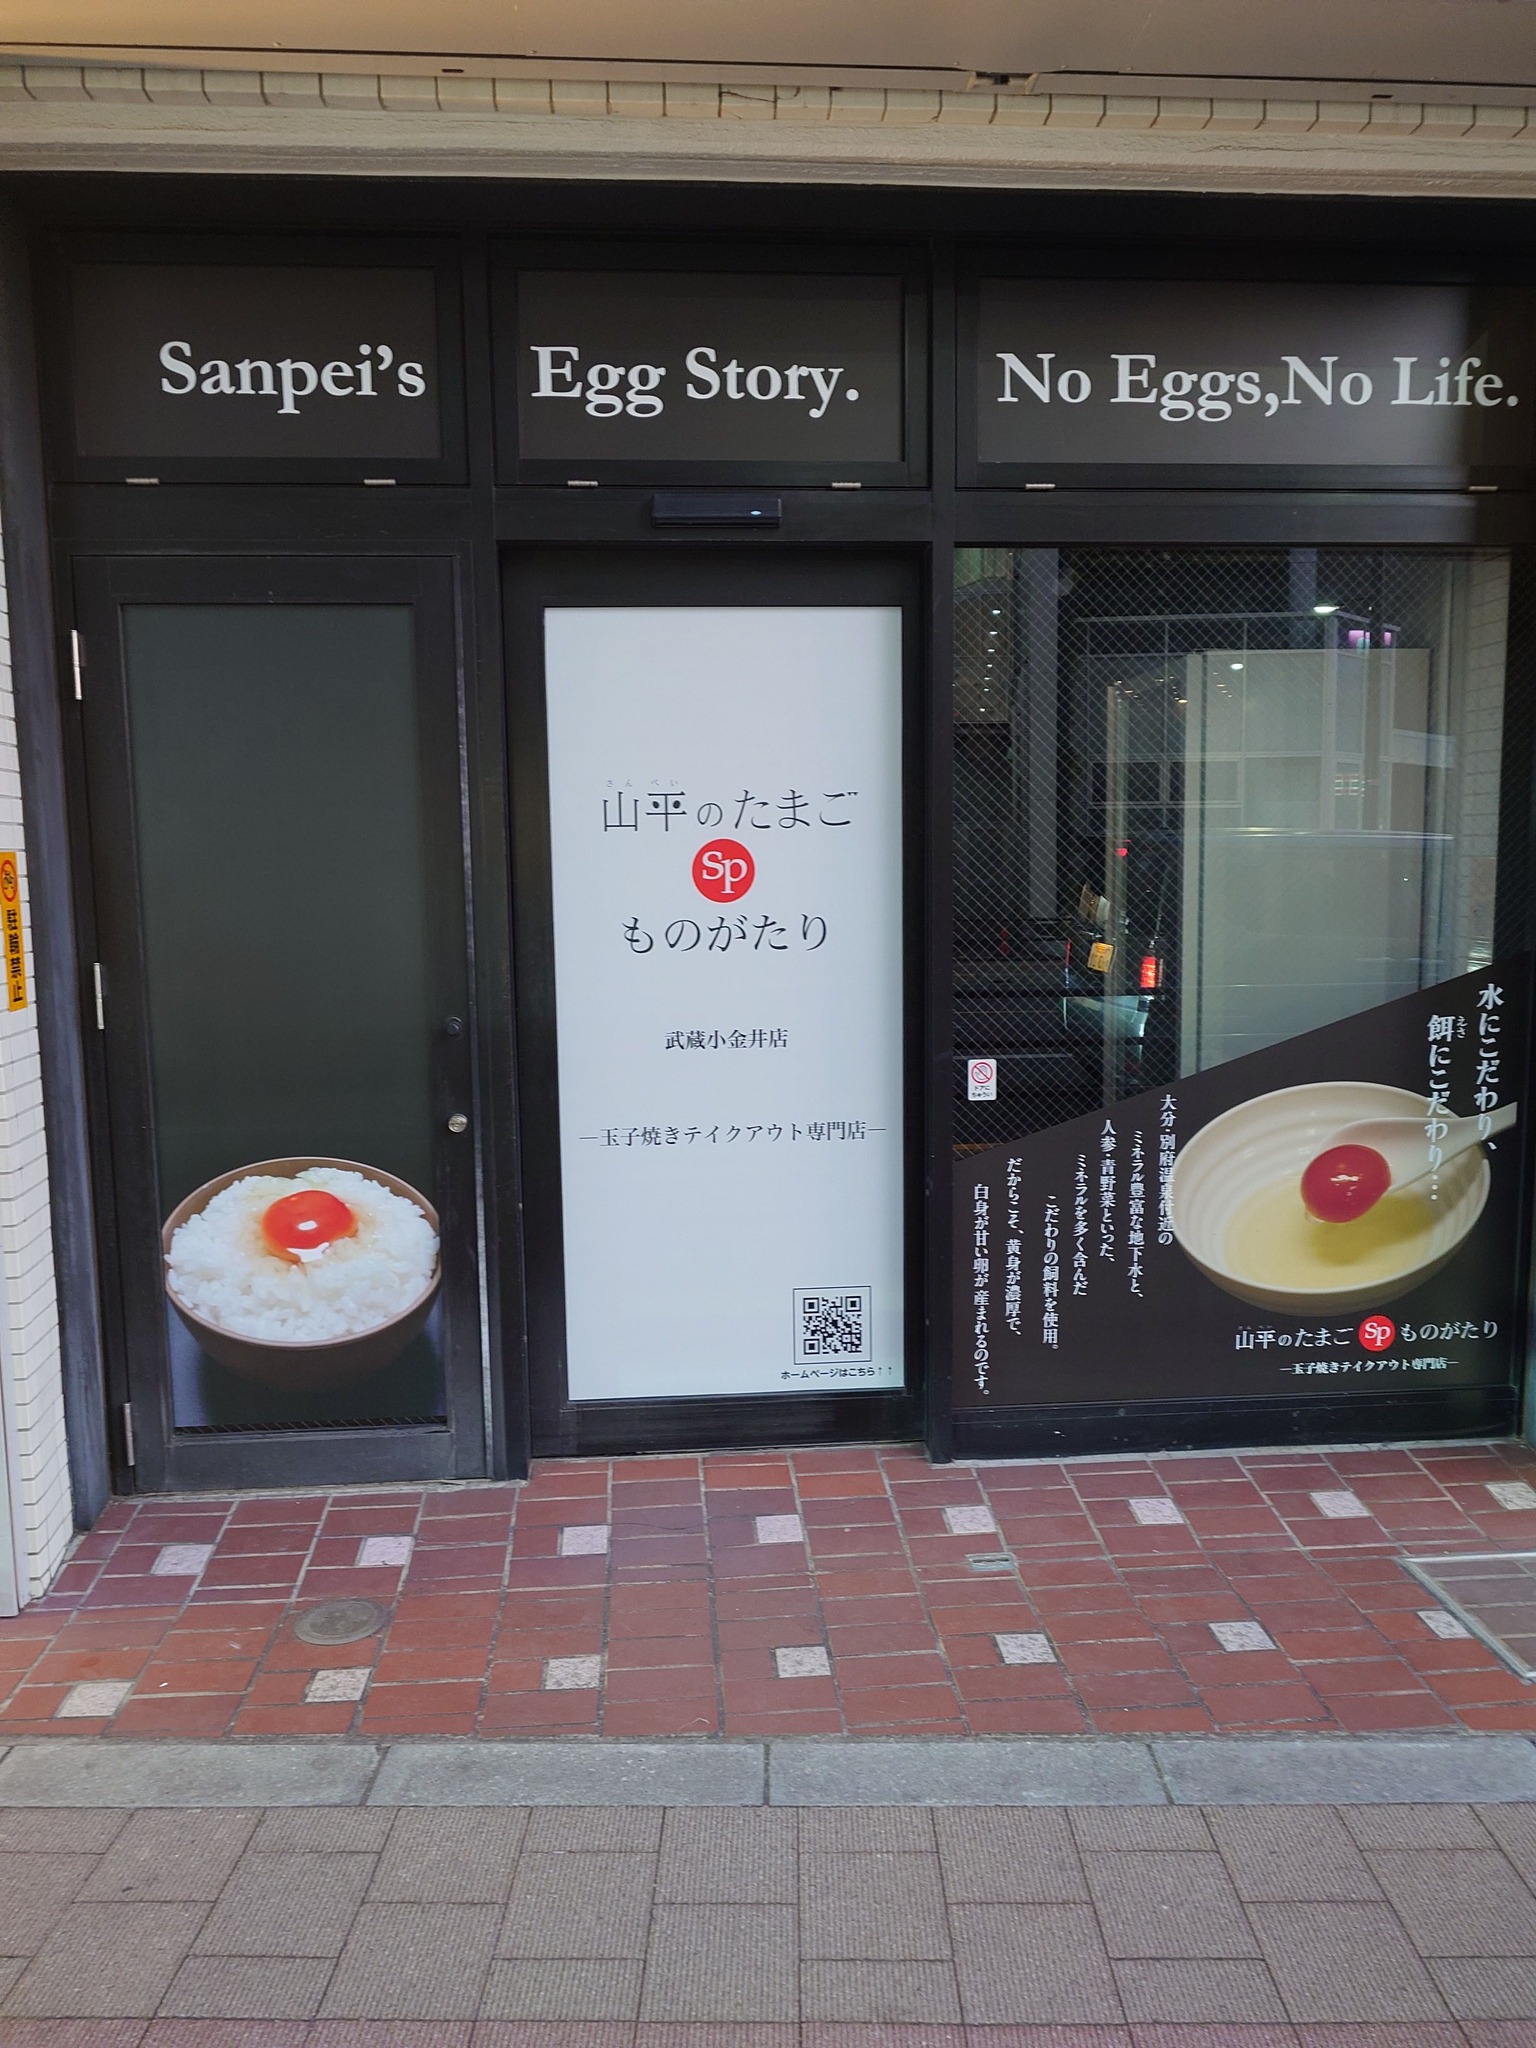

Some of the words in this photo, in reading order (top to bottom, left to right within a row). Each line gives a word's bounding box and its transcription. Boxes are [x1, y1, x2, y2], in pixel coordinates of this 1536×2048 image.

[159, 341, 426, 415] Sanpei's
[530, 345, 667, 418] Egg
[685, 346, 859, 419] Story.
[996, 353, 1092, 404] No
[1389, 356, 1518, 407] Life.
[602, 789, 859, 832] 山平のたまご
[622, 913, 827, 954] ものがたり
[665, 1028, 788, 1050] 武蔵小金井店
[1473, 983, 1505, 1151] 水にこだわり、
[1004, 1157, 1024, 1336] だからこそ、黄身が濃厚で、
[1072, 1154, 1089, 1296] ミネラルを多く含んだ
[1127, 1130, 1145, 1298] ミネラル豊富な地下水と、
[1042, 1195, 1060, 1350] こだわりの飼料を使用。
[1235, 1328, 1354, 1350] 山平のたまご
[1400, 1320, 1498, 1342] ものがたり
